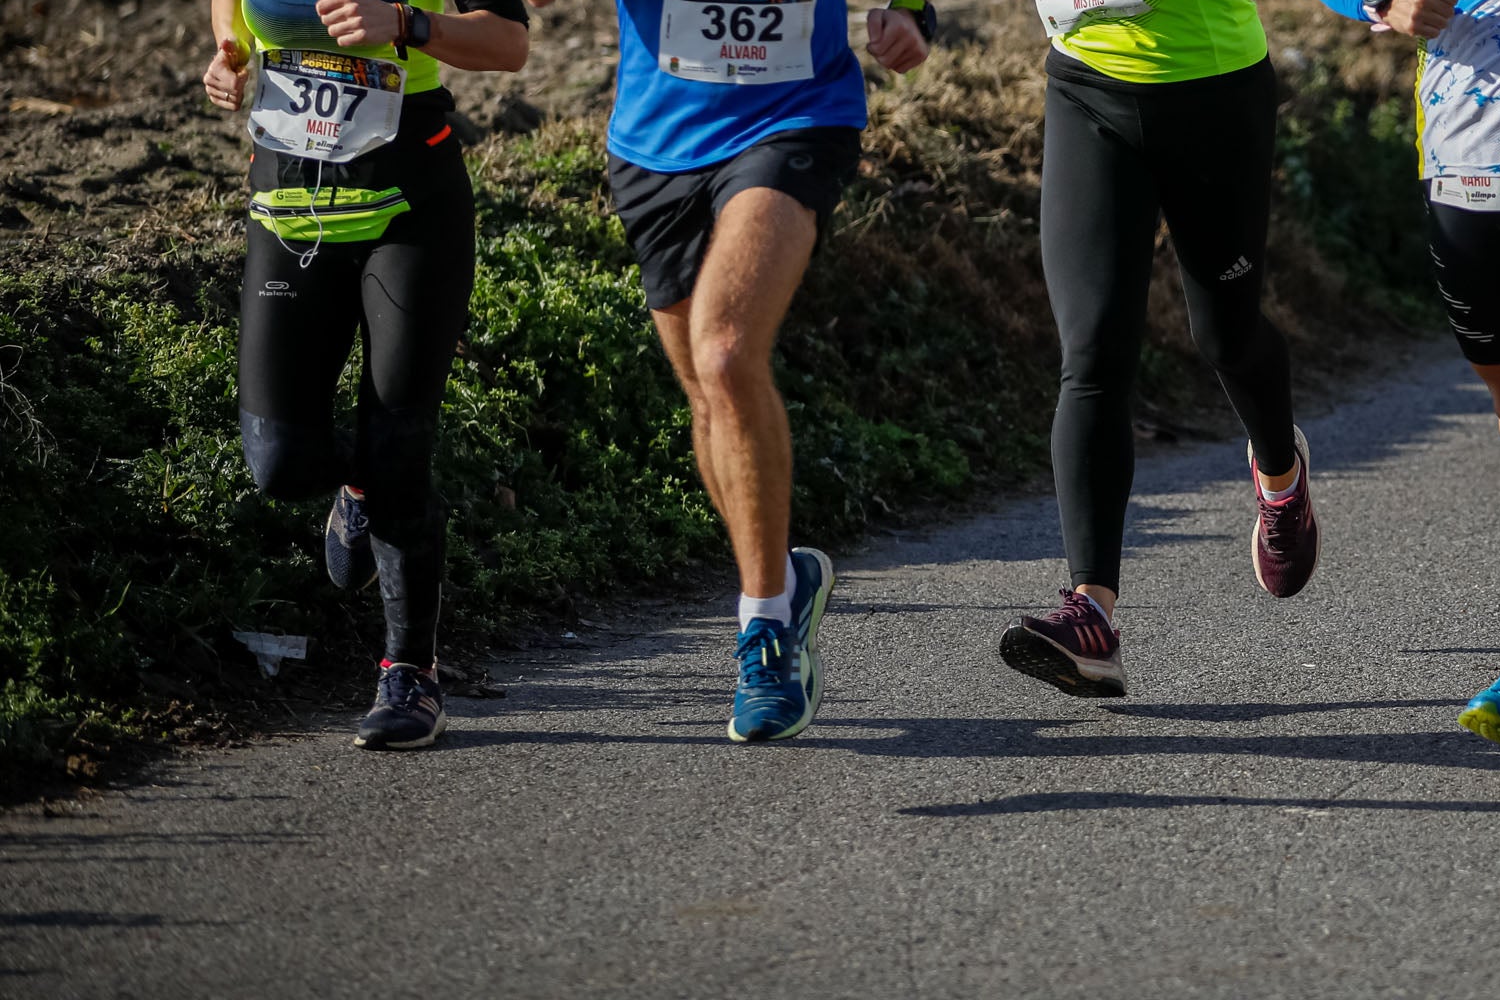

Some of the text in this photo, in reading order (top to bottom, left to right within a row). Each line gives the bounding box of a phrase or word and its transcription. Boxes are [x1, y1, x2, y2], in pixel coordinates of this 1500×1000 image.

[701, 5, 784, 41] 362
[302, 51, 353, 67] CARRERA
[720, 42, 766, 60] ÁLVARO
[301, 59, 351, 74] POPULAR
[289, 77, 368, 122] 307
[306, 119, 342, 138] MAITE
[258, 290, 297, 298] Kalenji
